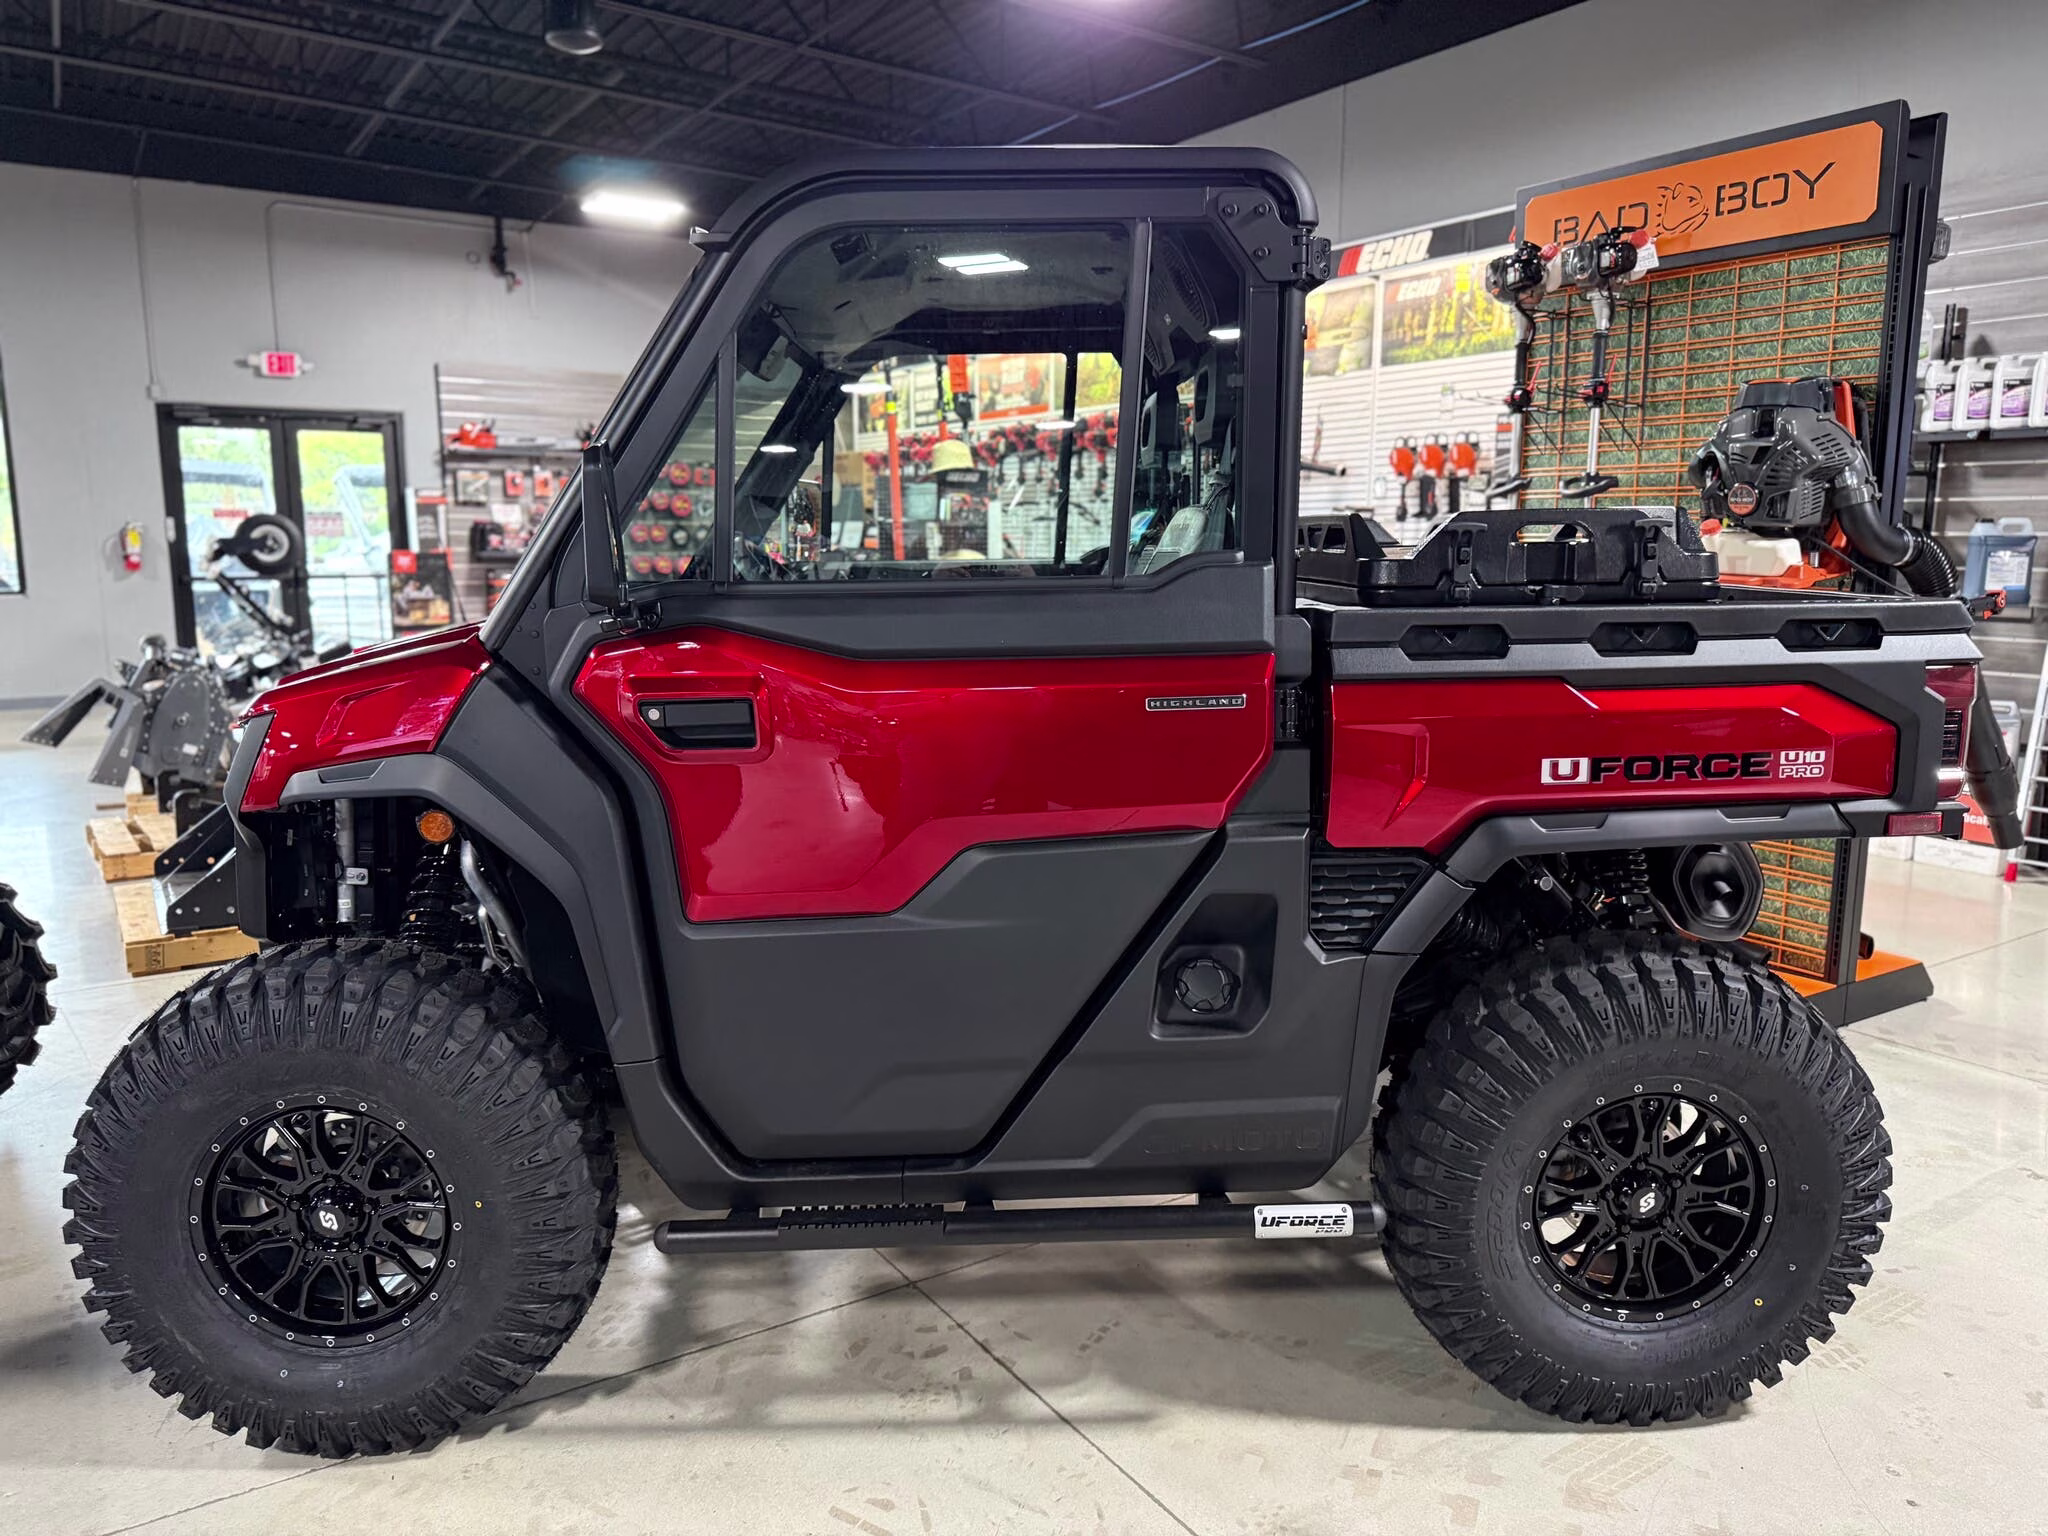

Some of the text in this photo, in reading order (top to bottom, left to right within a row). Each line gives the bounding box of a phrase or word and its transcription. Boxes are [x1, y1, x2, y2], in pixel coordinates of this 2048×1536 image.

[1553, 161, 1836, 246] BAD BOY
[1356, 230, 1433, 273] ECHO
[1398, 277, 1441, 302] ECHO
[1150, 698, 1242, 708] HIGHLAND
[1780, 750, 1826, 765] U10
[1779, 765, 1824, 779] PRO
[1261, 1215, 1347, 1228] UFORCE
